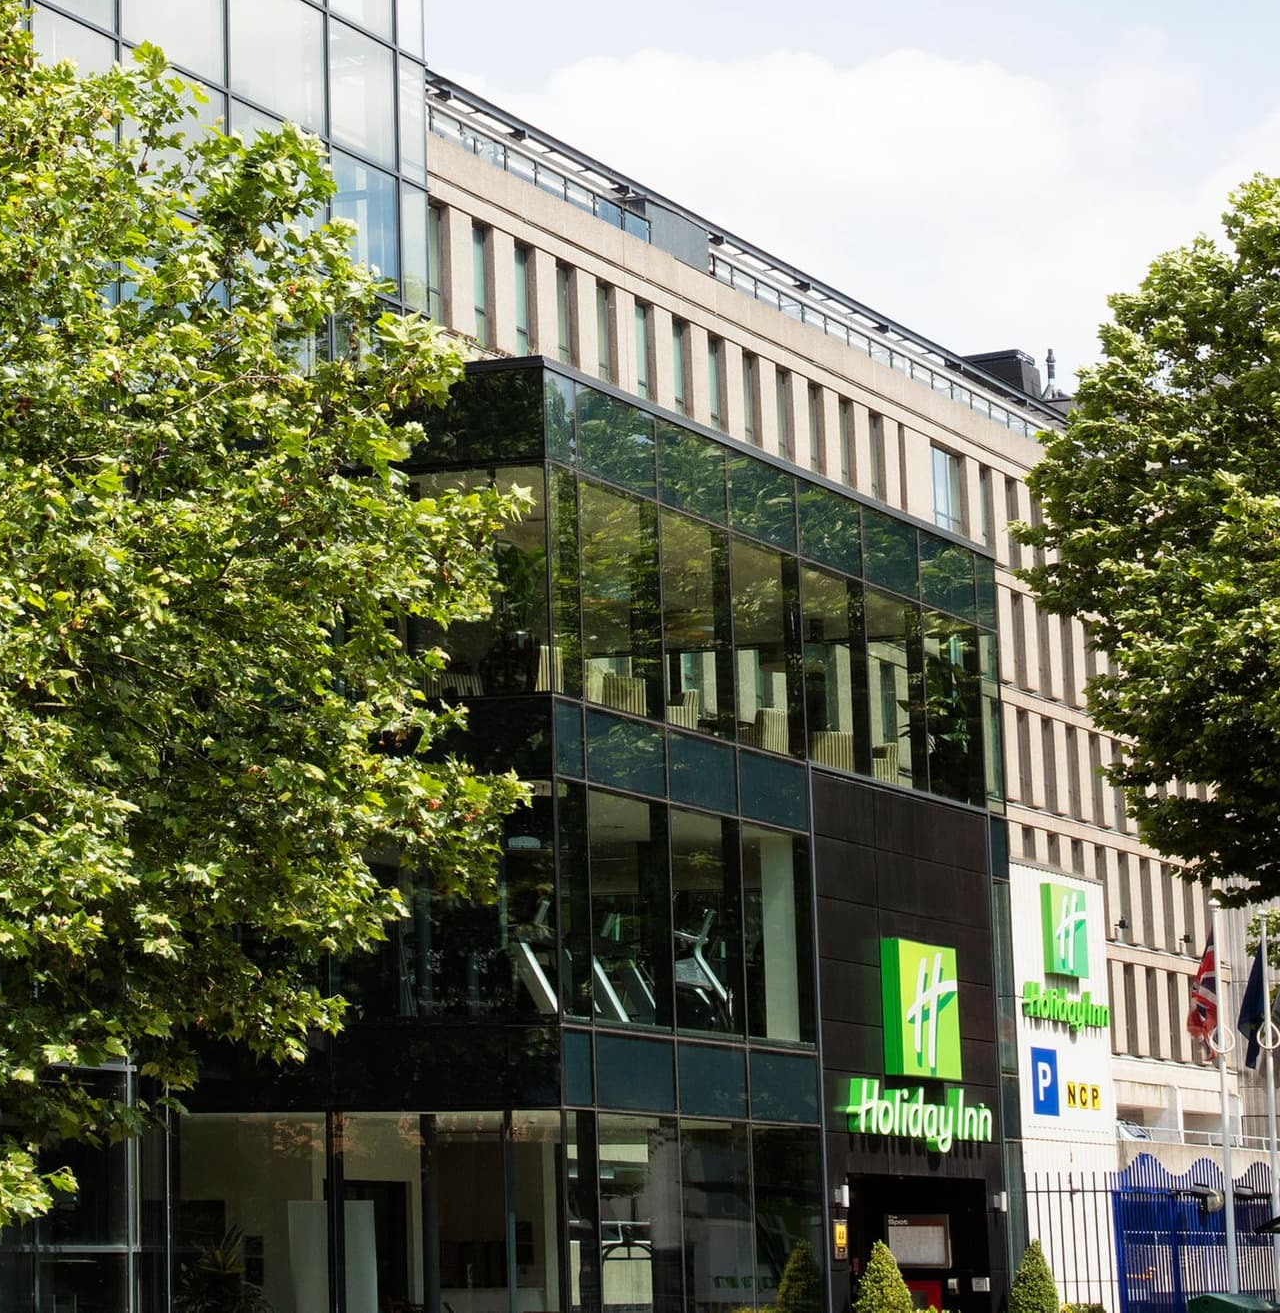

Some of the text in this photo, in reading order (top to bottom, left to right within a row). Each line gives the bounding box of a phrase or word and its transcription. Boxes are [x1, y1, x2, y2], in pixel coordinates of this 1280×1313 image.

[1022, 981, 1109, 1032] Holiday Inn
[1038, 1061, 1052, 1101] P
[1067, 1083, 1099, 1107] NCP
[850, 1078, 993, 1153] Holiday Inn
